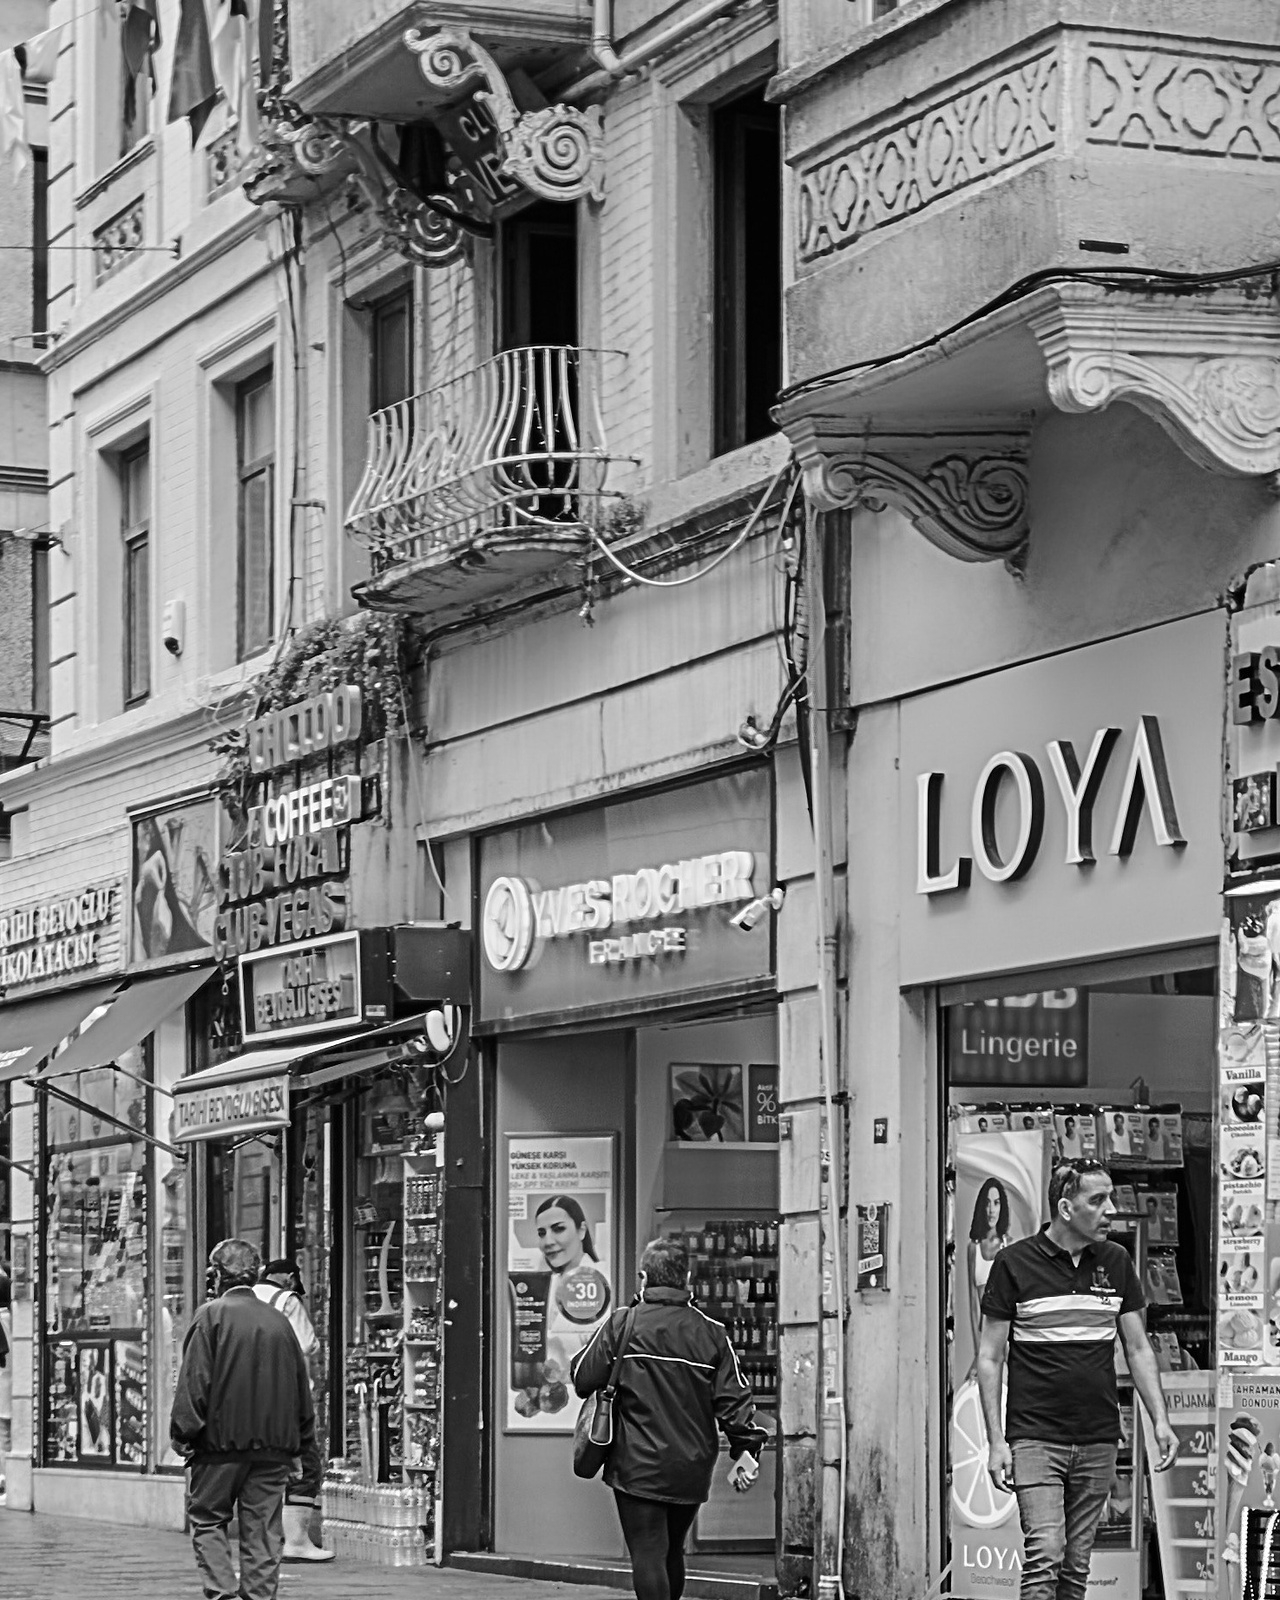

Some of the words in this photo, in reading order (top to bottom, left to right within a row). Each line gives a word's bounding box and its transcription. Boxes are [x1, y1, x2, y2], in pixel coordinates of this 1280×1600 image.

[264, 778, 333, 846] COFFEE
[916, 716, 1187, 896] LOYA
[531, 880, 613, 938] YVES
[613, 850, 755, 923] ROCHER
[266, 880, 340, 945] VEGAS
[588, 927, 687, 964] FRANCE
[961, 1029, 1078, 1063] Lingerie
[1225, 1068, 1262, 1081] Vanilla
[1225, 1293, 1259, 1302] lemon
[1223, 1352, 1258, 1368] Mango
[963, 1544, 1023, 1571] LOYA
[970, 1572, 1016, 1587] Beachwear
